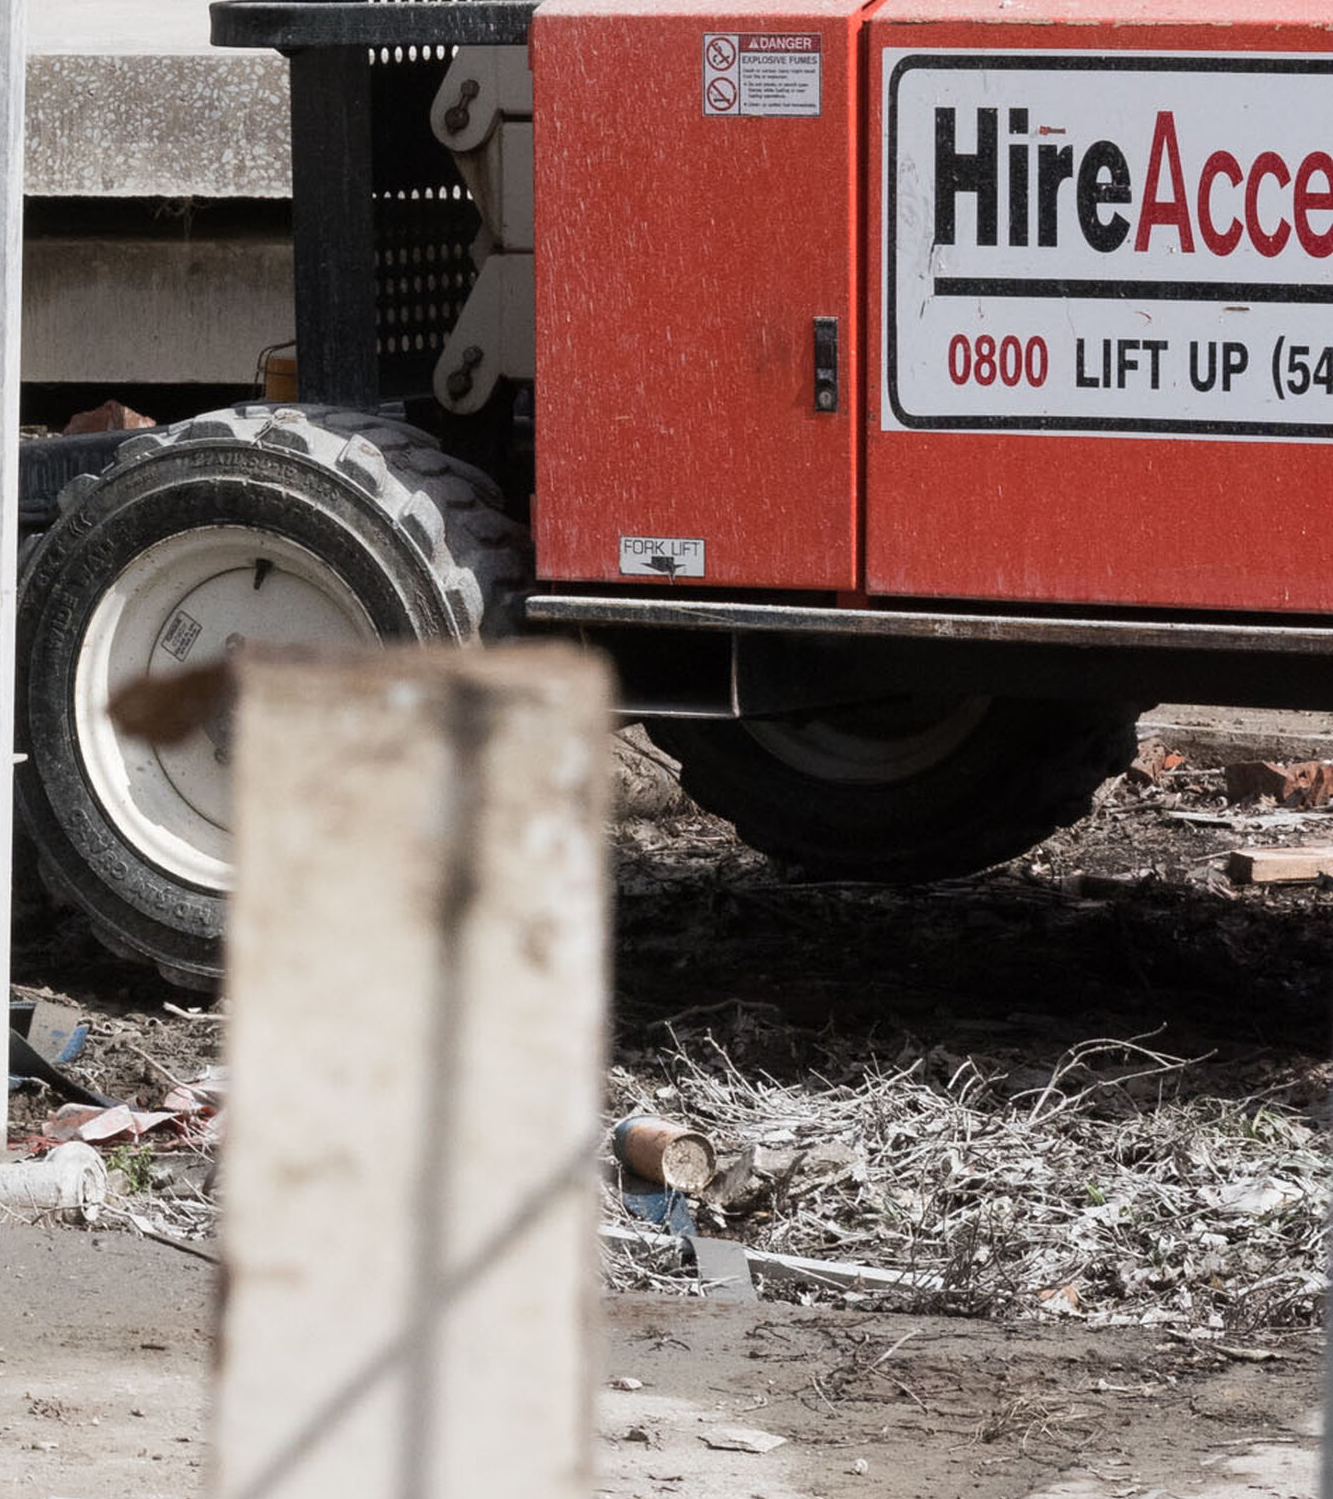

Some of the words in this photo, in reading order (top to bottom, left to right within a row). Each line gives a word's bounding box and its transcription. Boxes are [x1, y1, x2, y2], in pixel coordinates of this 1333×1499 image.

[759, 37, 813, 49] DANGER
[741, 55, 787, 65] EXPLOSIVE
[789, 55, 818, 65] FUMES
[948, 333, 1049, 388] 0800
[1075, 337, 1169, 390] LIFT
[1189, 340, 1249, 393] UP
[624, 539, 666, 555] FORK
[671, 541, 702, 557] LIFT
